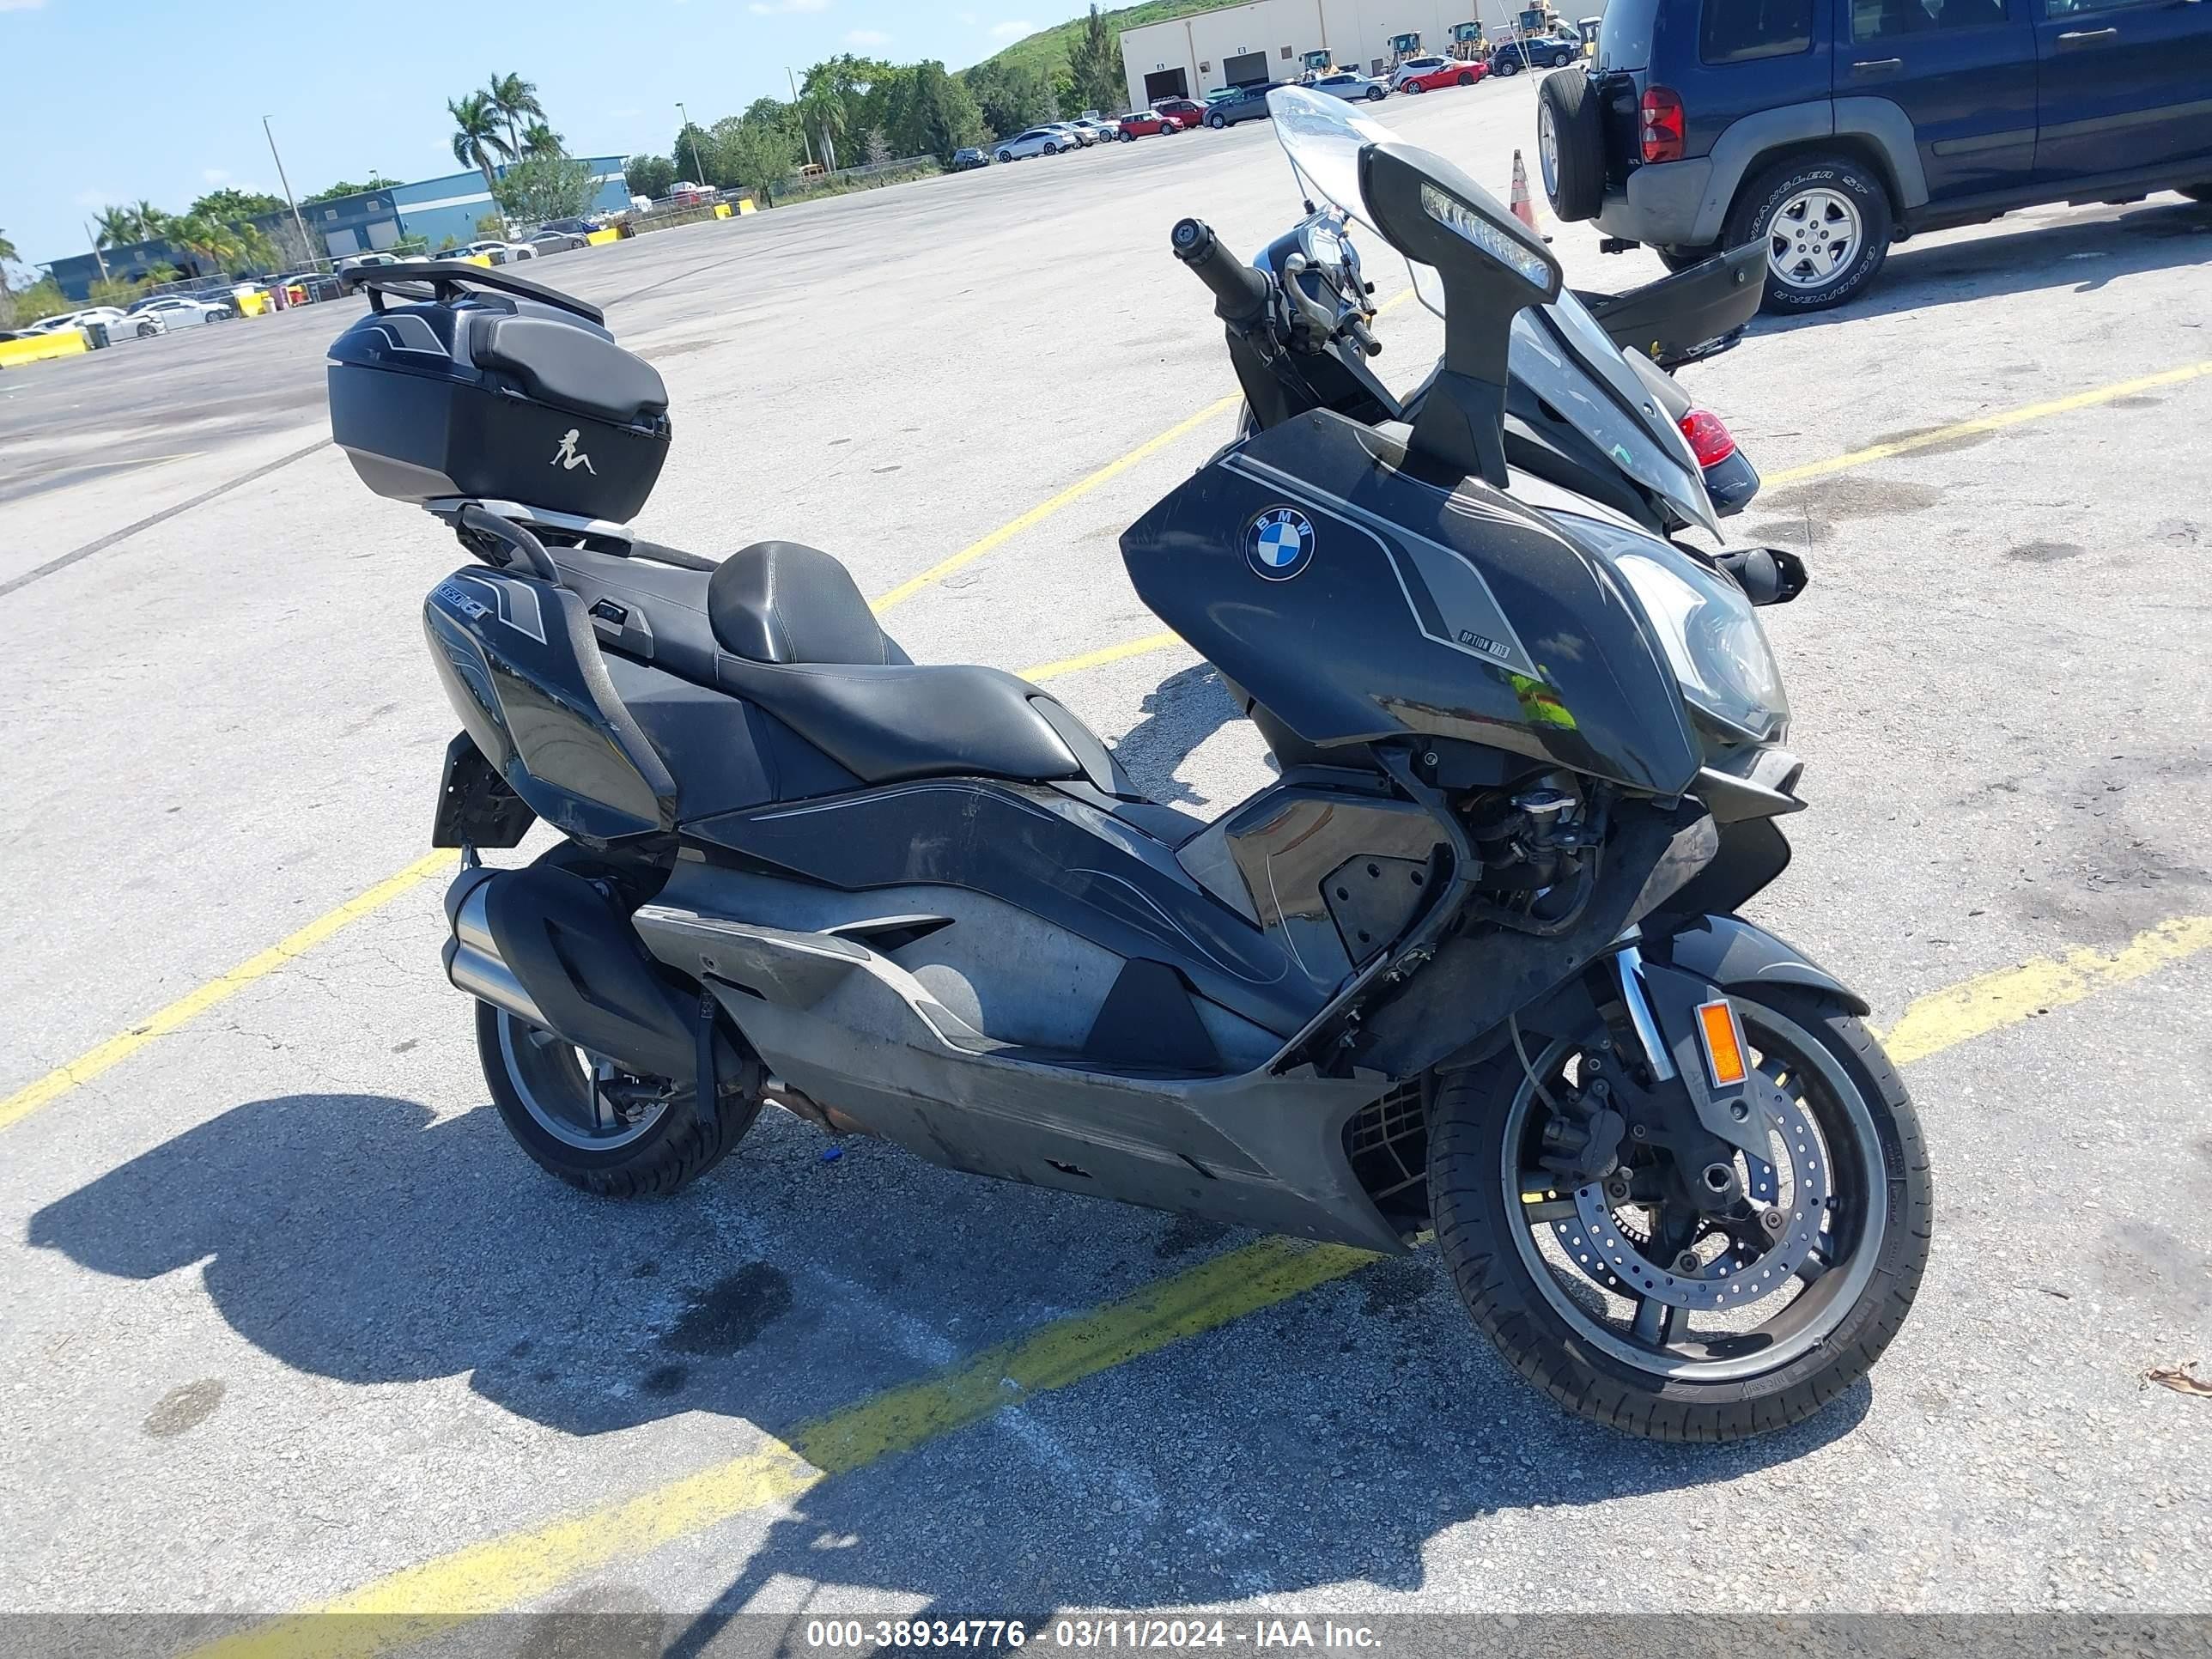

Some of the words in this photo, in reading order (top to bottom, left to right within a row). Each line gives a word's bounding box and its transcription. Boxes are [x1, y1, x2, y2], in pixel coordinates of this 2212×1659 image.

[1842, 175, 1868, 194] ST
[1773, 246, 1875, 304] GOODYEAR
[1256, 510, 1311, 537] BMW
[1462, 631, 1490, 650] OPTION
[1491, 642, 1509, 657] 719
